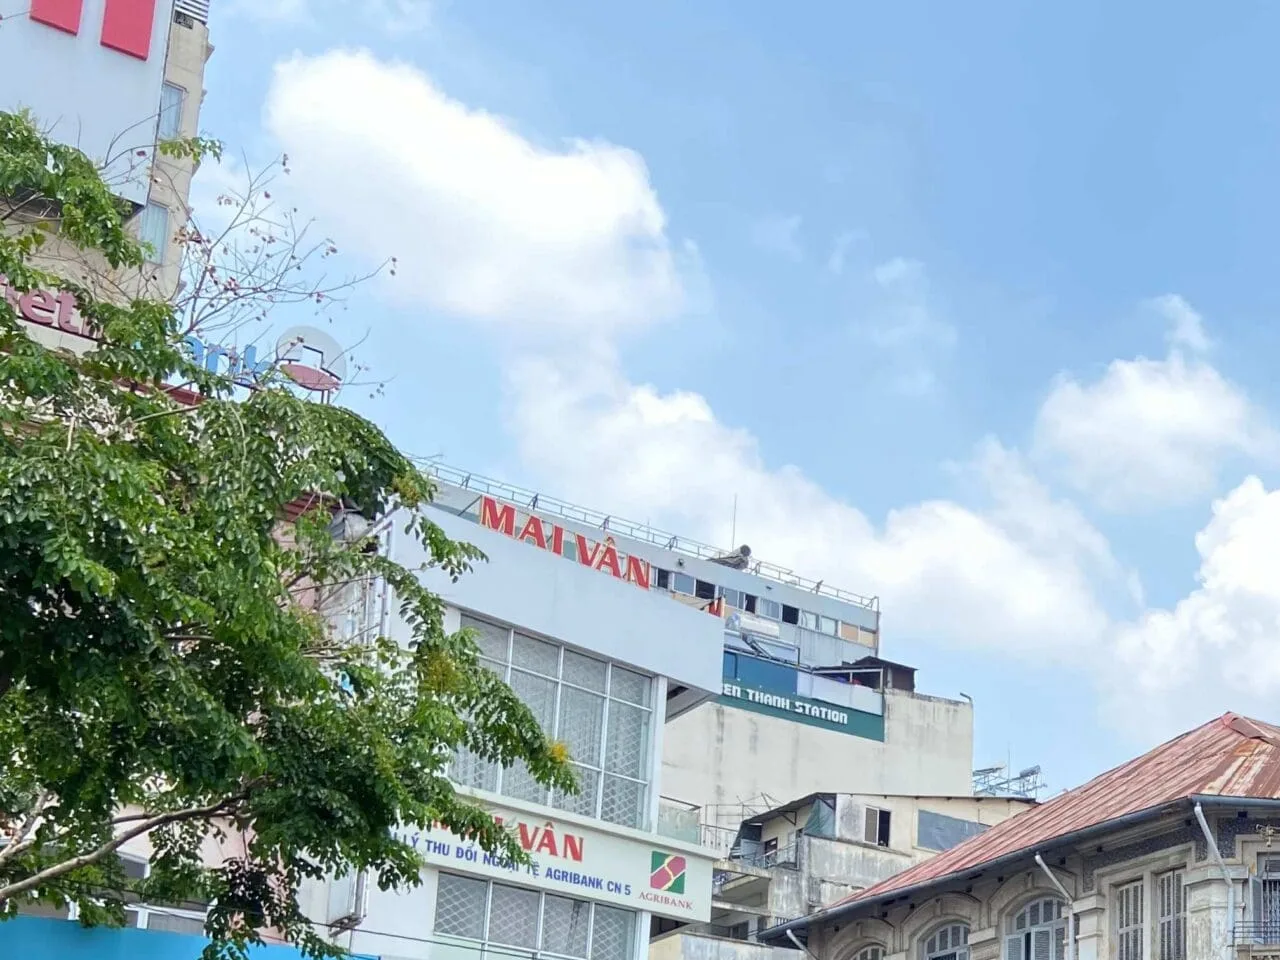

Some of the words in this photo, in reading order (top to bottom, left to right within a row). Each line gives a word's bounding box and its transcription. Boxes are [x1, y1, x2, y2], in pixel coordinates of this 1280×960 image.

[480, 494, 565, 557] MAI
[575, 535, 651, 592] VÂN
[747, 689, 790, 710] THANH
[795, 702, 848, 725] STATION
[517, 821, 584, 862] VÂN
[425, 839, 450, 856] THU
[456, 842, 478, 862] ĐỔI
[545, 867, 604, 890] AGRIBANK
[607, 880, 622, 895] CN
[625, 884, 632, 896] 5
[639, 891, 694, 911] AGRIBANK
